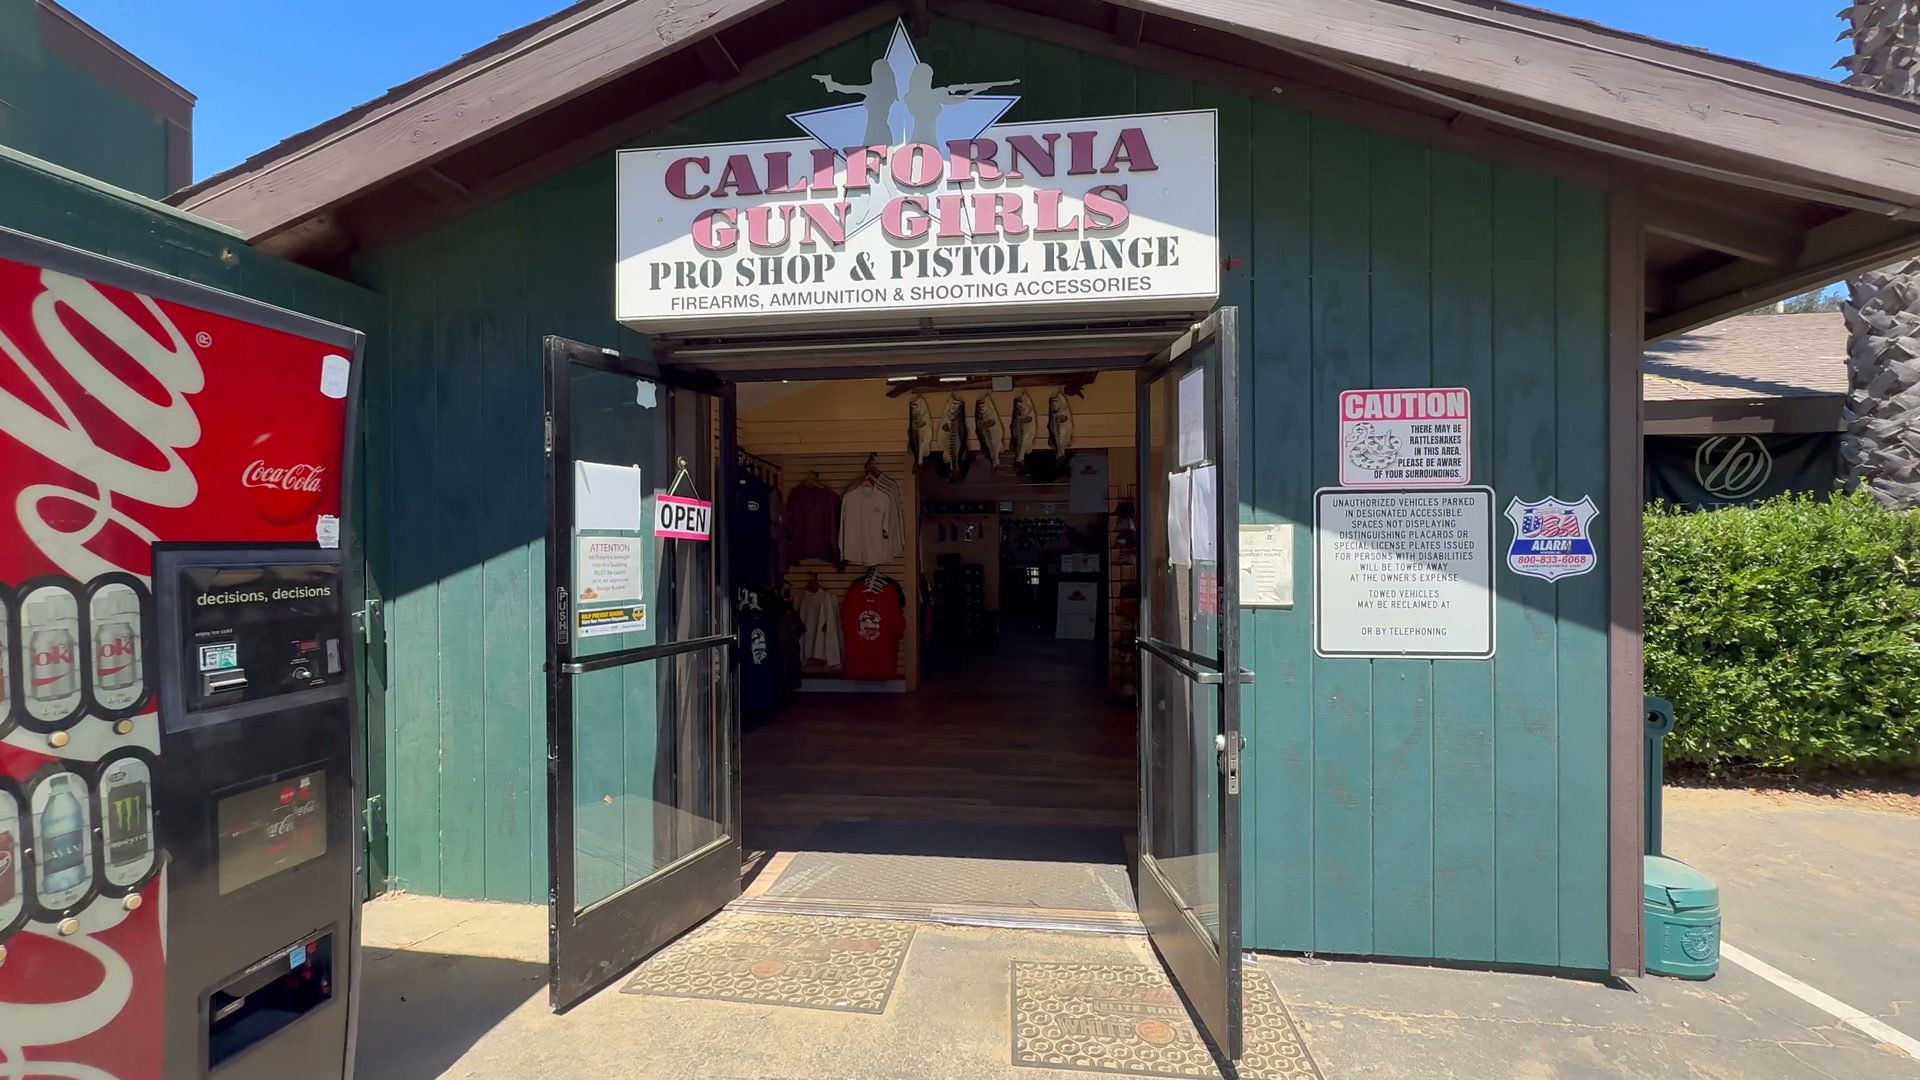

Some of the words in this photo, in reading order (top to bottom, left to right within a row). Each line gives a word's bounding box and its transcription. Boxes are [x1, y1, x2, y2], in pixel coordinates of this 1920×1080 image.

[664, 127, 1159, 200] CALIFORNIA
[691, 201, 852, 251] GUN
[880, 184, 1130, 241] GIRLS
[649, 259, 722, 291] PRO
[735, 253, 836, 288] SHOP
[849, 251, 876, 282] &
[890, 244, 1029, 280] PISTOL
[1043, 236, 1180, 272] RANGE
[671, 294, 764, 311] FIREARMS,
[769, 288, 893, 308] AMMUNITION
[893, 287, 905, 301] &
[910, 282, 1008, 300] SHOOTING
[1014, 276, 1152, 297] ACCESSORIES
[1345, 392, 1465, 419] CAUTION
[1411, 425, 1432, 434] THERE
[1434, 425, 1451, 433] MAY
[1453, 424, 1462, 433] BE
[1409, 435, 1462, 445] RATTLESNAKES
[1414, 447, 1421, 456] IN
[1424, 447, 1440, 456] THIS
[1441, 446, 1462, 456] AREA.
[1398, 459, 1424, 467] PLEASE
[1426, 459, 1435, 467] BE
[1437, 458, 1462, 467] AWARE
[241, 459, 326, 492] Coca-Cola
[1374, 470, 1383, 479] OF
[1385, 470, 1404, 479] YOUR
[1405, 469, 1462, 478] SURROUNDINGS.
[1332, 498, 1396, 508] UNAUTHORIZED
[1399, 498, 1439, 507] VEHICLES
[1442, 497, 1475, 506] PARKED
[661, 503, 706, 533] OPEN
[1345, 509, 1354, 518] IN
[1356, 509, 1407, 518] DESIGNATED
[1410, 508, 1462, 517] ACCESSIBLE
[1351, 520, 1384, 529] SPACES
[1386, 520, 1402, 528] NOT
[1405, 519, 1456, 528] DISPLAYING
[1521, 514, 1581, 538] USA
[1339, 531, 1406, 540] DISTINGUISHING
[1408, 530, 1454, 539] PLACARDS
[1457, 530, 1469, 539] OR
[589, 543, 631, 553] ATTENTION
[1333, 541, 1368, 550] SPECIAL
[1371, 541, 1406, 550] LICENSE
[1408, 541, 1441, 549] PLATES
[1443, 541, 1475, 549] ISSUED
[1531, 540, 1572, 551] ALARM
[1335, 552, 1351, 561] FOR
[1354, 552, 1393, 561] PERSONS
[1395, 552, 1416, 560] WITH
[1418, 551, 1474, 560] DISABILITIES
[1517, 555, 1587, 564] 800-833-6068
[1360, 563, 1379, 571] WILL
[1381, 563, 1392, 571] BE
[1395, 562, 1423, 571] TOWED
[1426, 562, 1448, 571] AWAY
[1350, 574, 1360, 582] AT
[1362, 574, 1377, 582] THE
[1380, 573, 1417, 582] OWNER'S
[1420, 573, 1459, 582] EXPENSE
[196, 590, 268, 606] decisions,
[272, 586, 331, 600] decisions
[1369, 589, 1397, 598] TOWED
[1399, 589, 1440, 598] VEHICLES
[1357, 600, 1374, 609] MAY
[1377, 600, 1388, 609] BE
[1391, 600, 1438, 609] RECLAIMED
[1440, 600, 1451, 609] AT
[559, 592, 567, 630] PUSH
[1361, 627, 1373, 636] OR
[1375, 627, 1387, 636] BY
[1390, 627, 1447, 636] TELEPHONING
